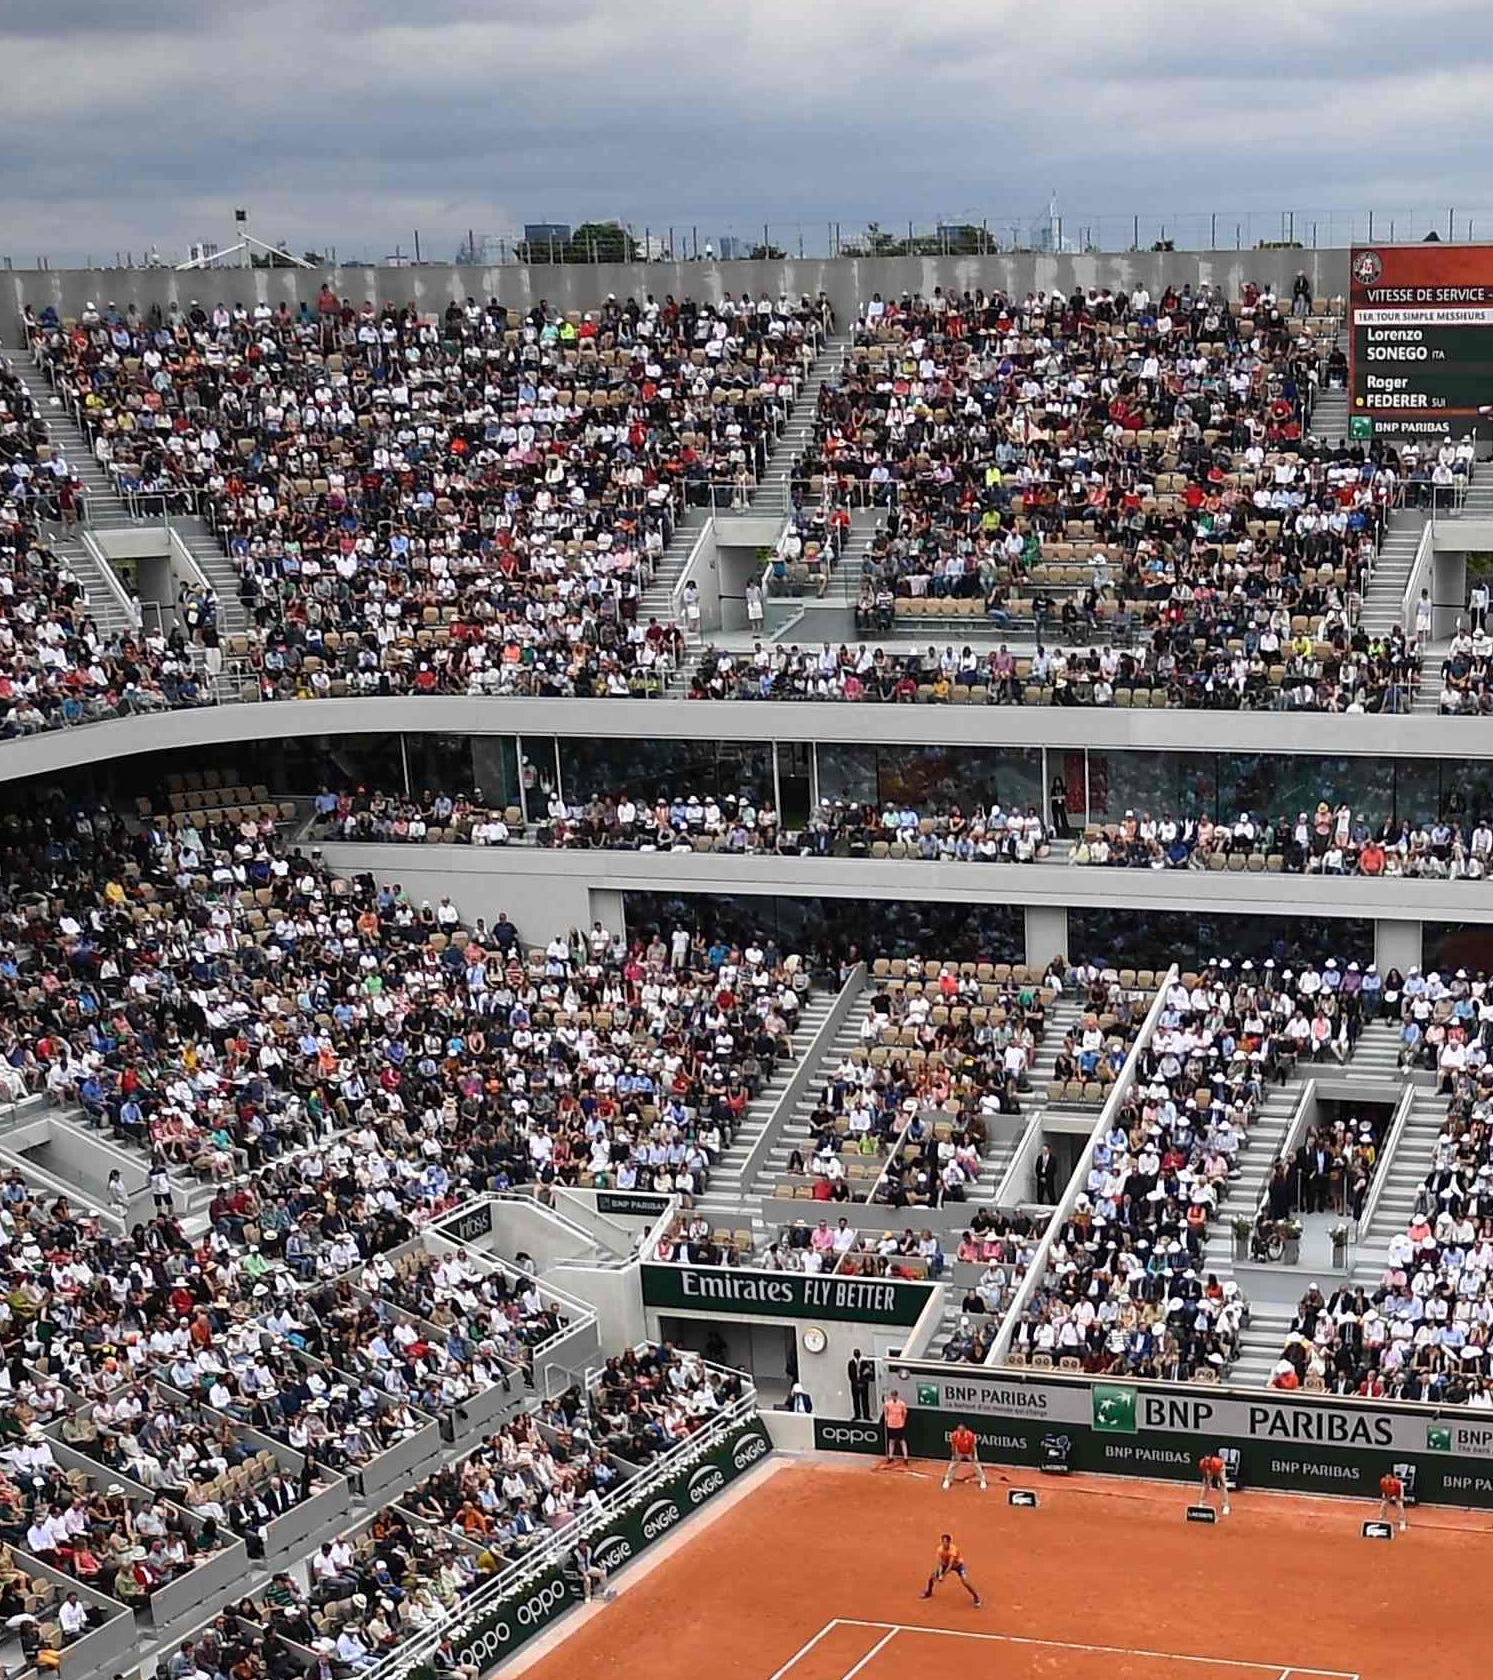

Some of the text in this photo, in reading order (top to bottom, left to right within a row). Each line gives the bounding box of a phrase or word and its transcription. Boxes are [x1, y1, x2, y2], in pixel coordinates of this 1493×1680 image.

[1367, 289, 1414, 301] VITESSE
[1417, 289, 1434, 301] DE
[1436, 288, 1484, 301] SERVICE
[1376, 313, 1400, 321] TOUR
[1403, 312, 1433, 321] SIMPLE
[1436, 311, 1485, 320] MESSIEURS
[1367, 327, 1423, 341] Lorenzo
[1367, 346, 1445, 361] SONEGO ITA
[1367, 375, 1408, 391] Roger
[1367, 394, 1446, 408] FEDERER SUI
[1375, 422, 1449, 432] BNP PARIBAS
[680, 1270, 895, 1311] Emirates FLY BETTER
[945, 1386, 1048, 1408] BNP PARIBAS
[1145, 1398, 1393, 1446] BNP PARIBAS
[822, 1426, 878, 1444] oppo
[975, 1433, 1028, 1449] PARIBAS
[1458, 1430, 1493, 1446] BNP
[1106, 1445, 1191, 1465] BNP PARIBAS
[1271, 1461, 1360, 1480] BNP PARIBAS
[1443, 1476, 1471, 1490] BNP
[517, 1581, 565, 1625] oppo
[459, 1622, 510, 1667] oppo
